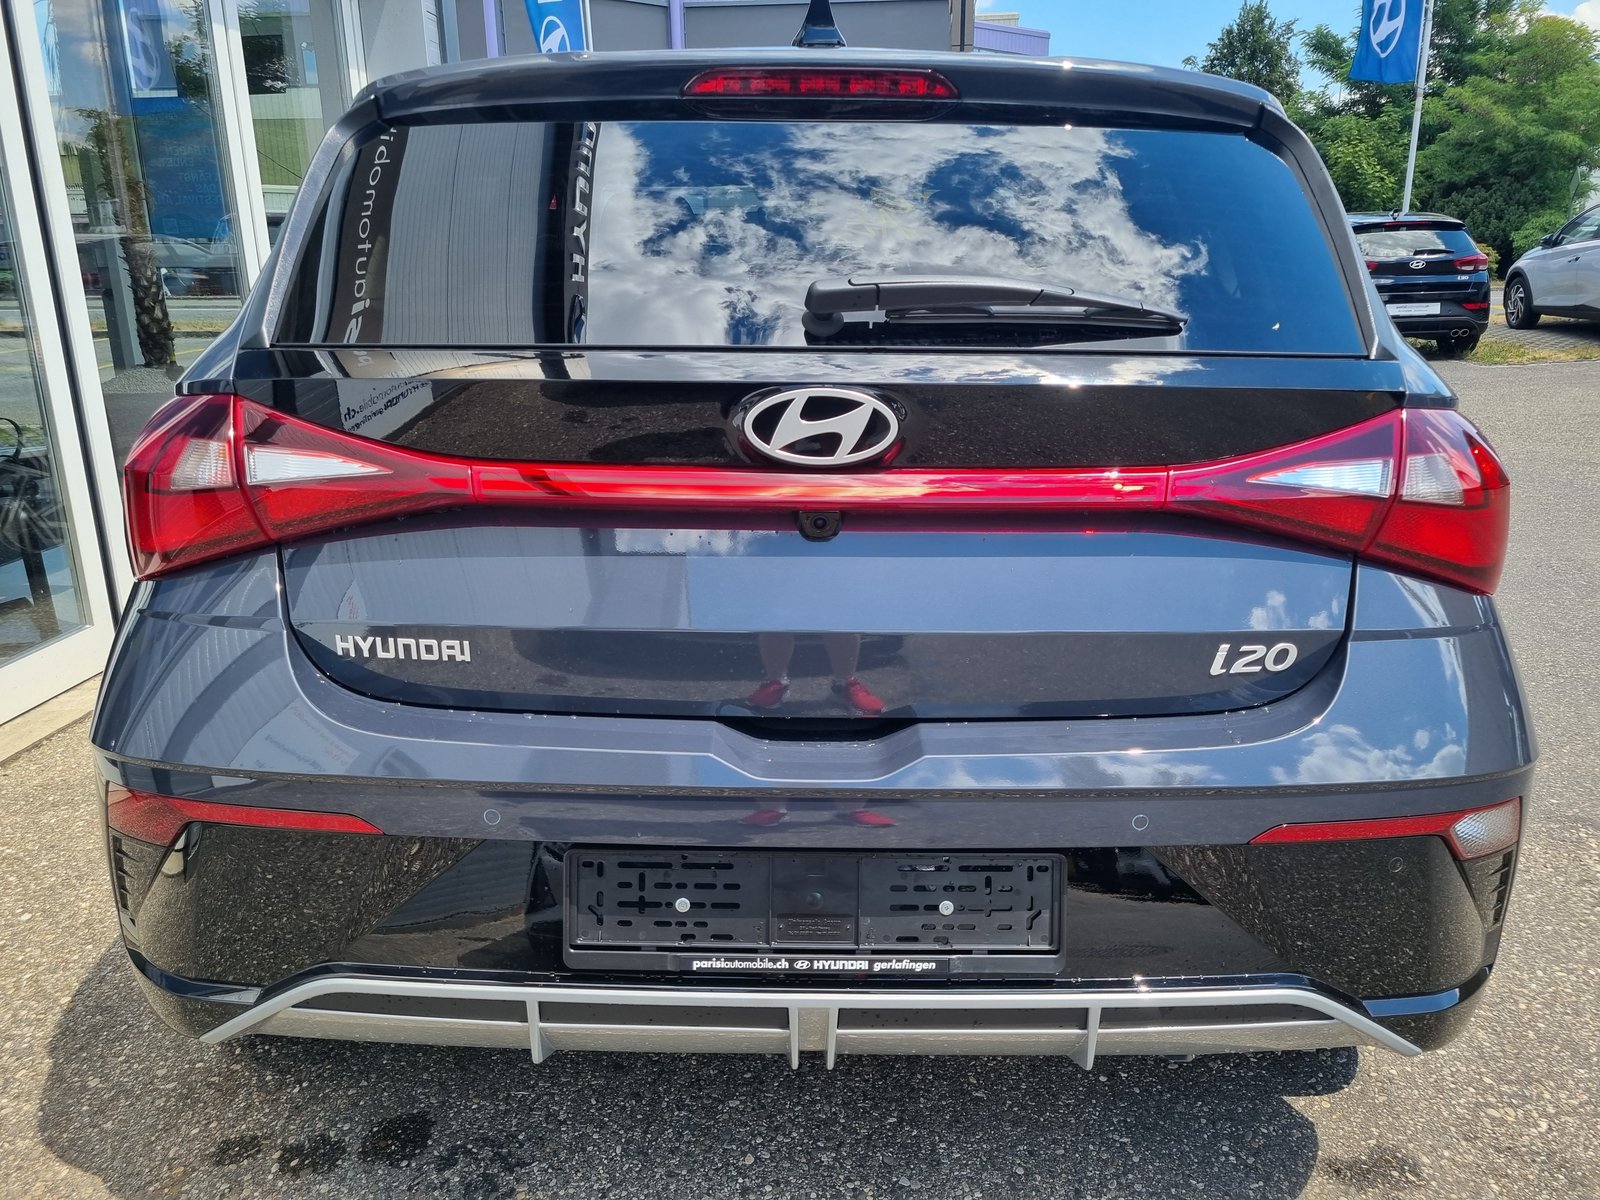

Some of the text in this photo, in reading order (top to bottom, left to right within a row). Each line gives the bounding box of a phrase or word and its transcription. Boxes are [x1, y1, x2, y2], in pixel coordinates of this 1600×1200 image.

[335, 634, 471, 662] HYUNDAI
[1209, 642, 1298, 676] i20
[692, 957, 937, 972] parisiautomobile.ch HYUNDAI gerlafingen
